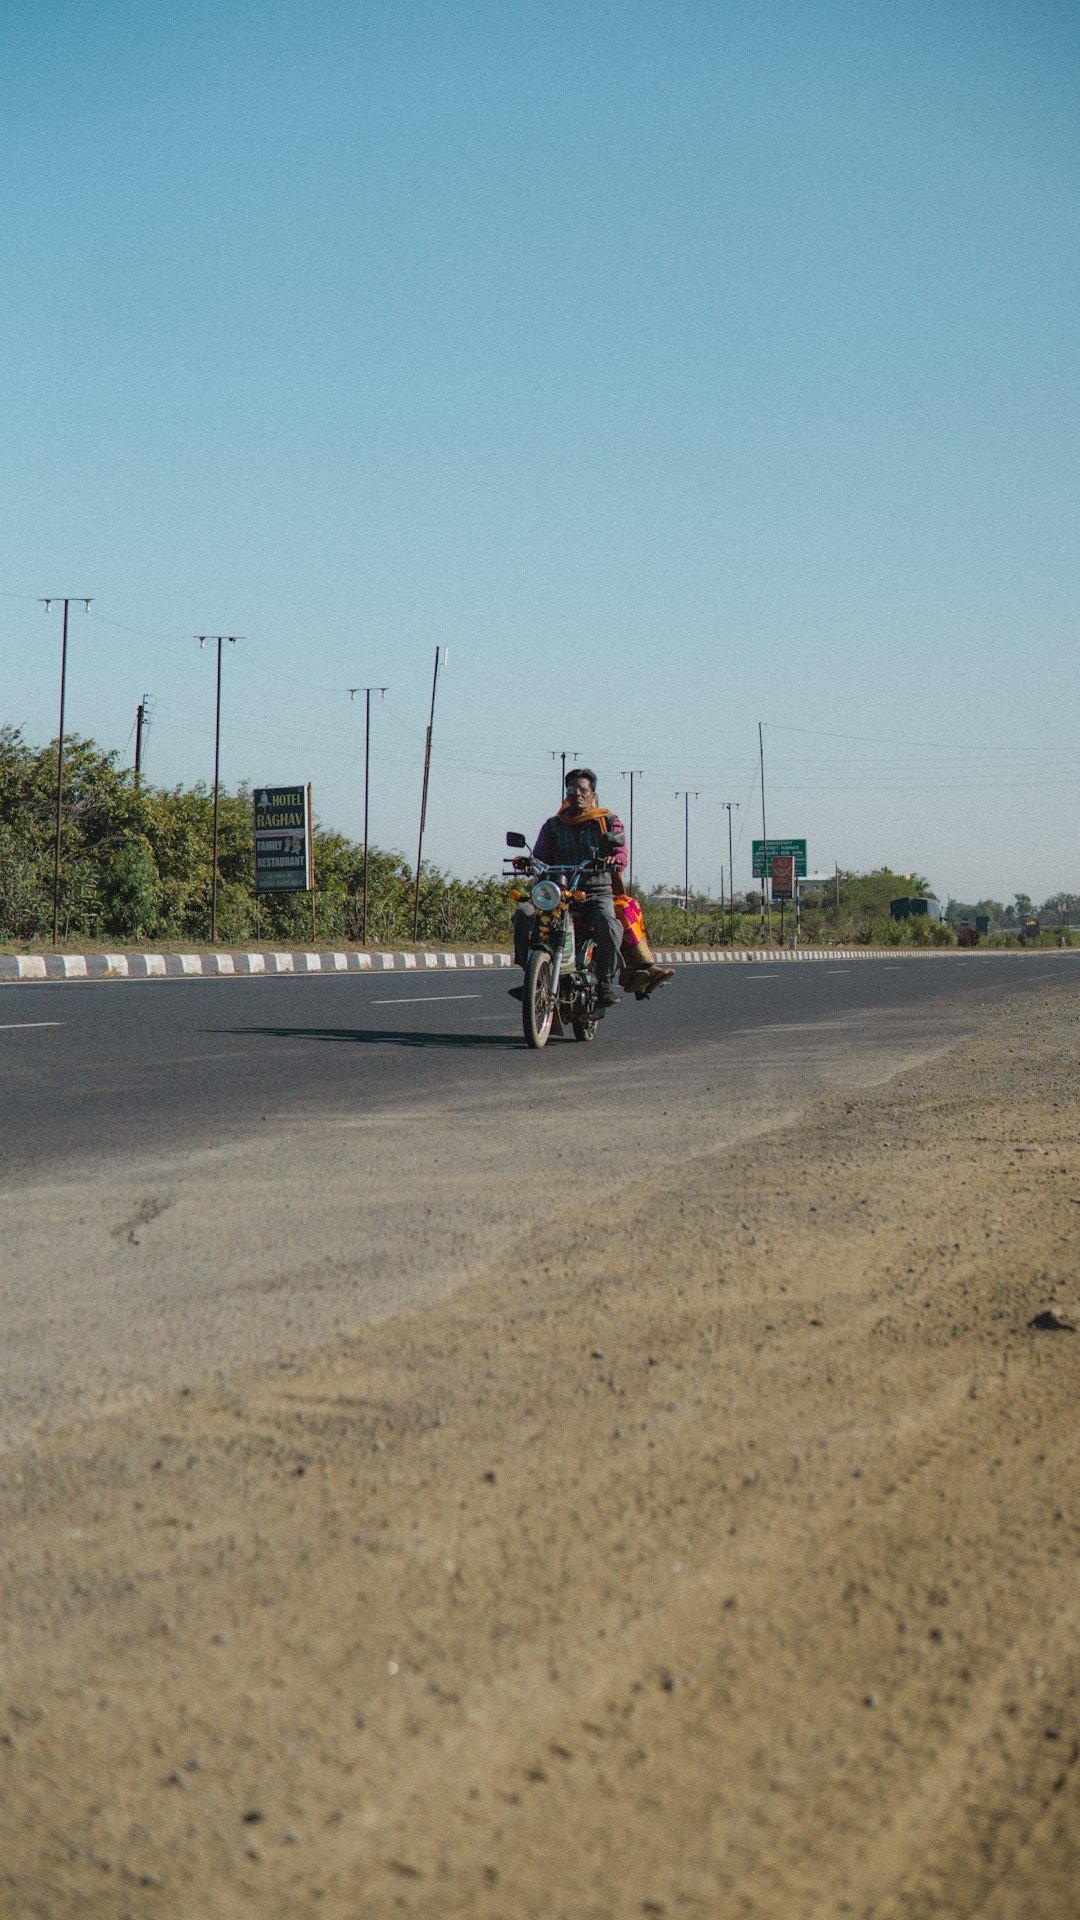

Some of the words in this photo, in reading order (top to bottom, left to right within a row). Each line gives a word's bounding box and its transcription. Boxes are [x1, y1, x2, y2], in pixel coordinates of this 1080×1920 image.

[272, 794, 303, 806] HOTEL
[257, 813, 302, 827] RAGHAV
[256, 840, 283, 851] FAMILY
[257, 856, 304, 868] RESTAURANT
